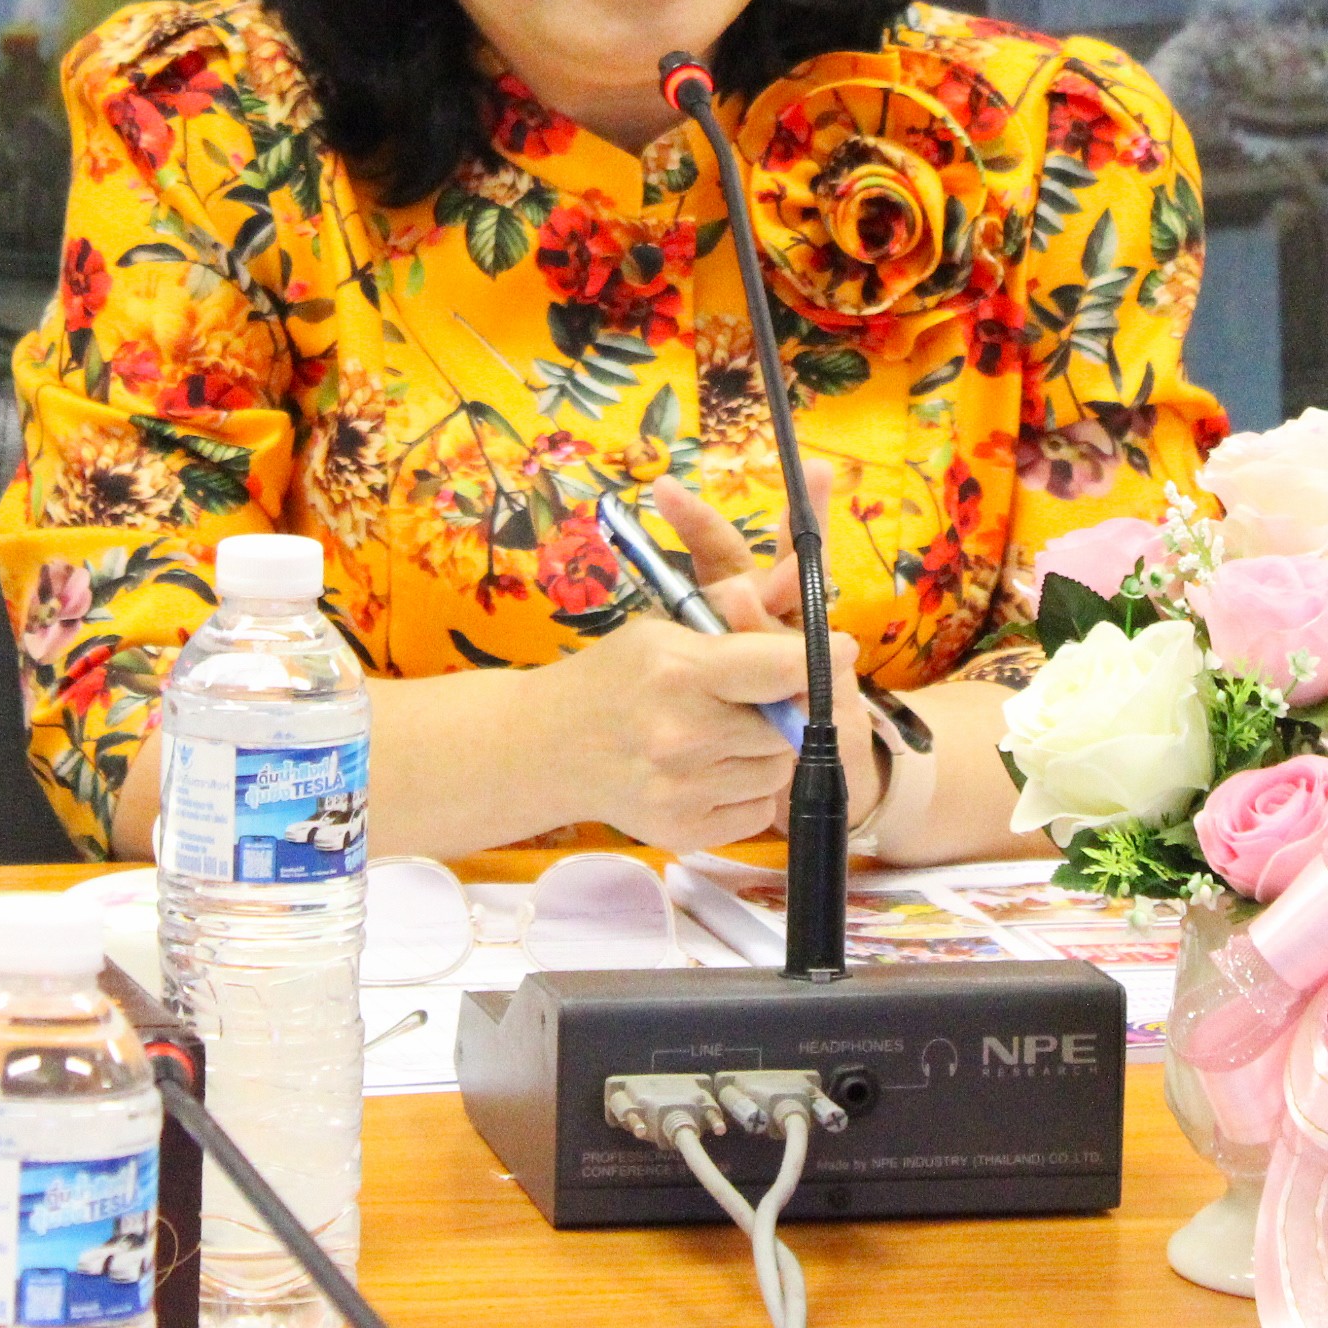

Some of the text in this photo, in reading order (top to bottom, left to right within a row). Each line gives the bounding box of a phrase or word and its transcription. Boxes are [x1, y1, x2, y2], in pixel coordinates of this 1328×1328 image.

[292, 772, 344, 797] TESLA
[690, 1044, 723, 1058] LINE
[798, 1038, 905, 1054] HEADPHONES
[982, 1033, 1098, 1066] NPE
[982, 1066, 1099, 1078] RESEARCH
[871, 1156, 898, 1169] NPE
[902, 1155, 968, 1169] INDUSTRY
[88, 1192, 140, 1220] TESL
